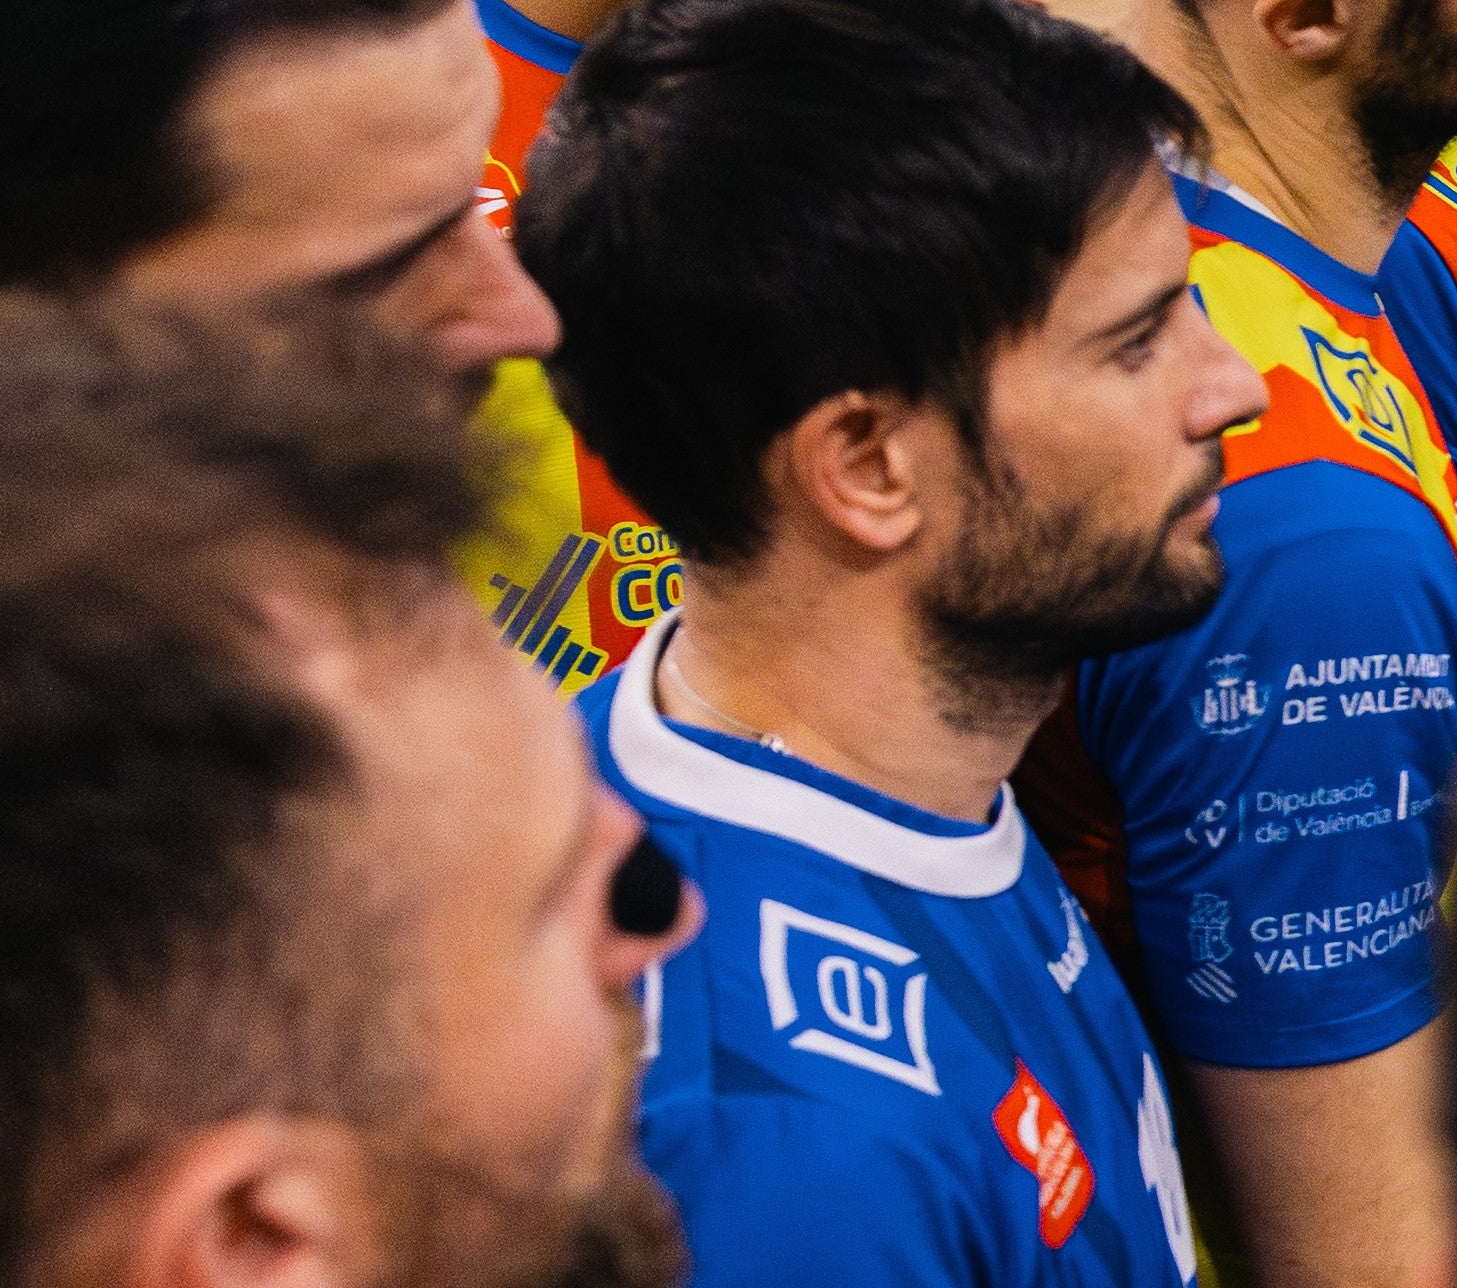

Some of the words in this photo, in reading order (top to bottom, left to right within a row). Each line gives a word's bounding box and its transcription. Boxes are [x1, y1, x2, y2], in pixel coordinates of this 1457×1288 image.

[1283, 696, 1328, 726] DE
[1257, 777, 1376, 816] Diputació
[1255, 820, 1290, 844] de
[1294, 805, 1393, 837] València
[1250, 878, 1436, 943] GENERALITA
[1254, 906, 1436, 975] VALENCIANA
